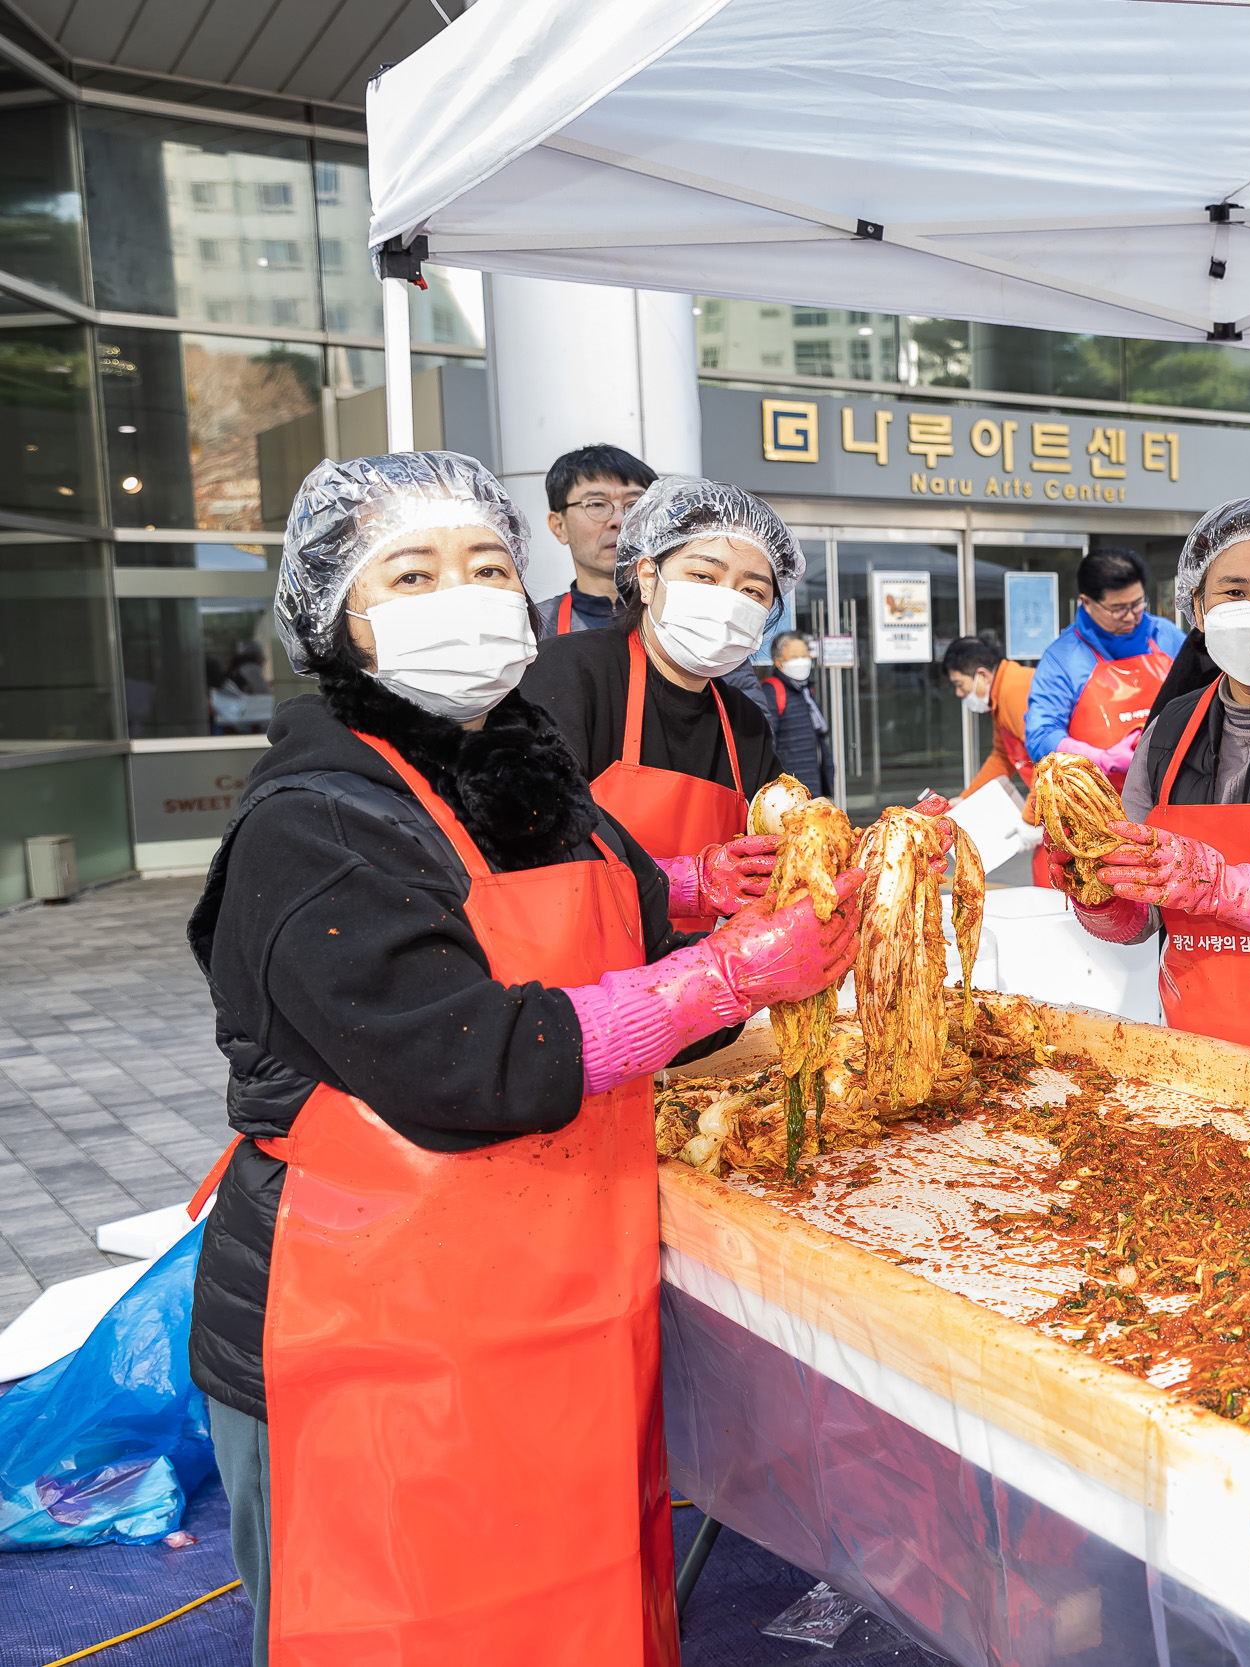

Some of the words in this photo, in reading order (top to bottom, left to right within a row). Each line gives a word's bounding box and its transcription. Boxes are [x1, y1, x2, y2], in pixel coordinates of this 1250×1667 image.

[842, 407, 1179, 482] 나루아트센터
[911, 472, 973, 496] Naru
[985, 477, 1033, 499] Arts
[1044, 479, 1126, 503] Center
[165, 795, 233, 814] SWEET
[1173, 934, 1194, 951] 광진
[1197, 935, 1236, 952] 사랑의
